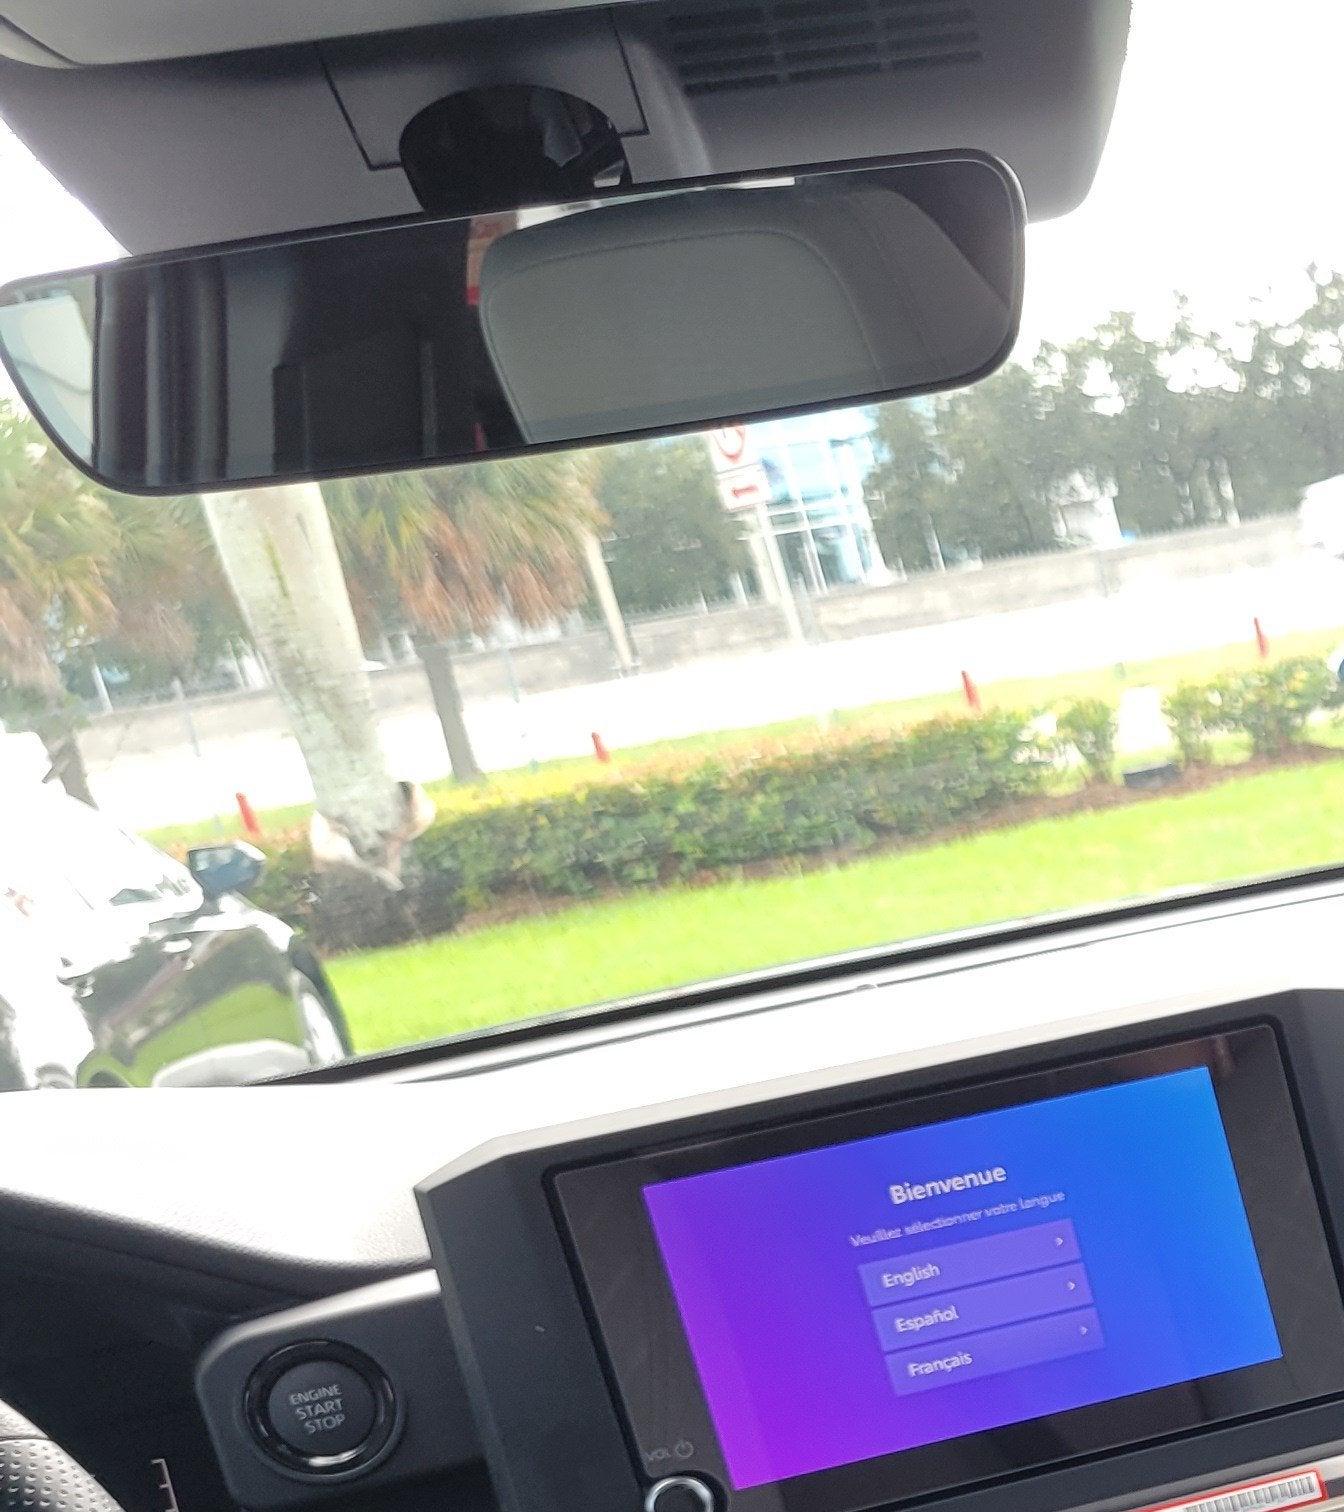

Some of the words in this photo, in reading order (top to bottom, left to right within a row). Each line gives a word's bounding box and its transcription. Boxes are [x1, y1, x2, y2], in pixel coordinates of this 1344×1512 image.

[889, 1166, 1008, 1205] Bienvenue
[1020, 1190, 1067, 1209] langue
[882, 1262, 941, 1289] English
[894, 1304, 960, 1334] Español
[907, 1351, 974, 1378] Français
[289, 1383, 342, 1406] ENGINE
[295, 1398, 343, 1420] START
[304, 1413, 346, 1435] STOP
